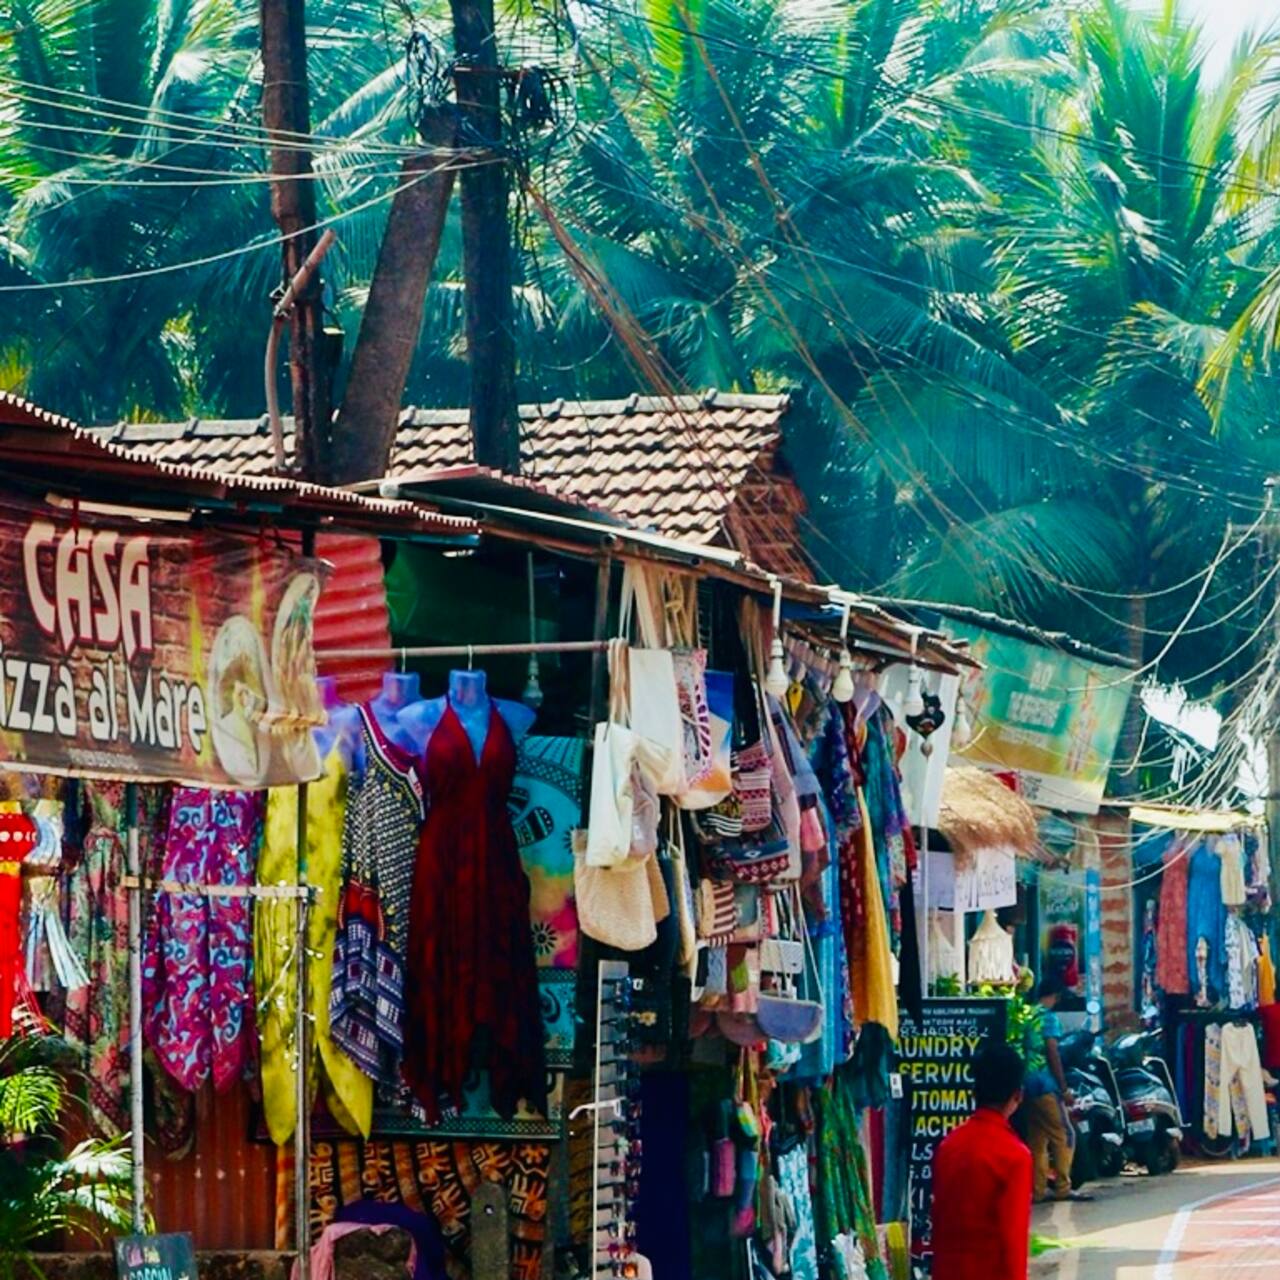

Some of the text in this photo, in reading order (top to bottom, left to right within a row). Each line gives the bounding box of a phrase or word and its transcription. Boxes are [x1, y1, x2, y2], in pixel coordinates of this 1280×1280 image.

[23, 521, 153, 664] CASA
[89, 654, 119, 742] al
[127, 662, 208, 755] Mare
